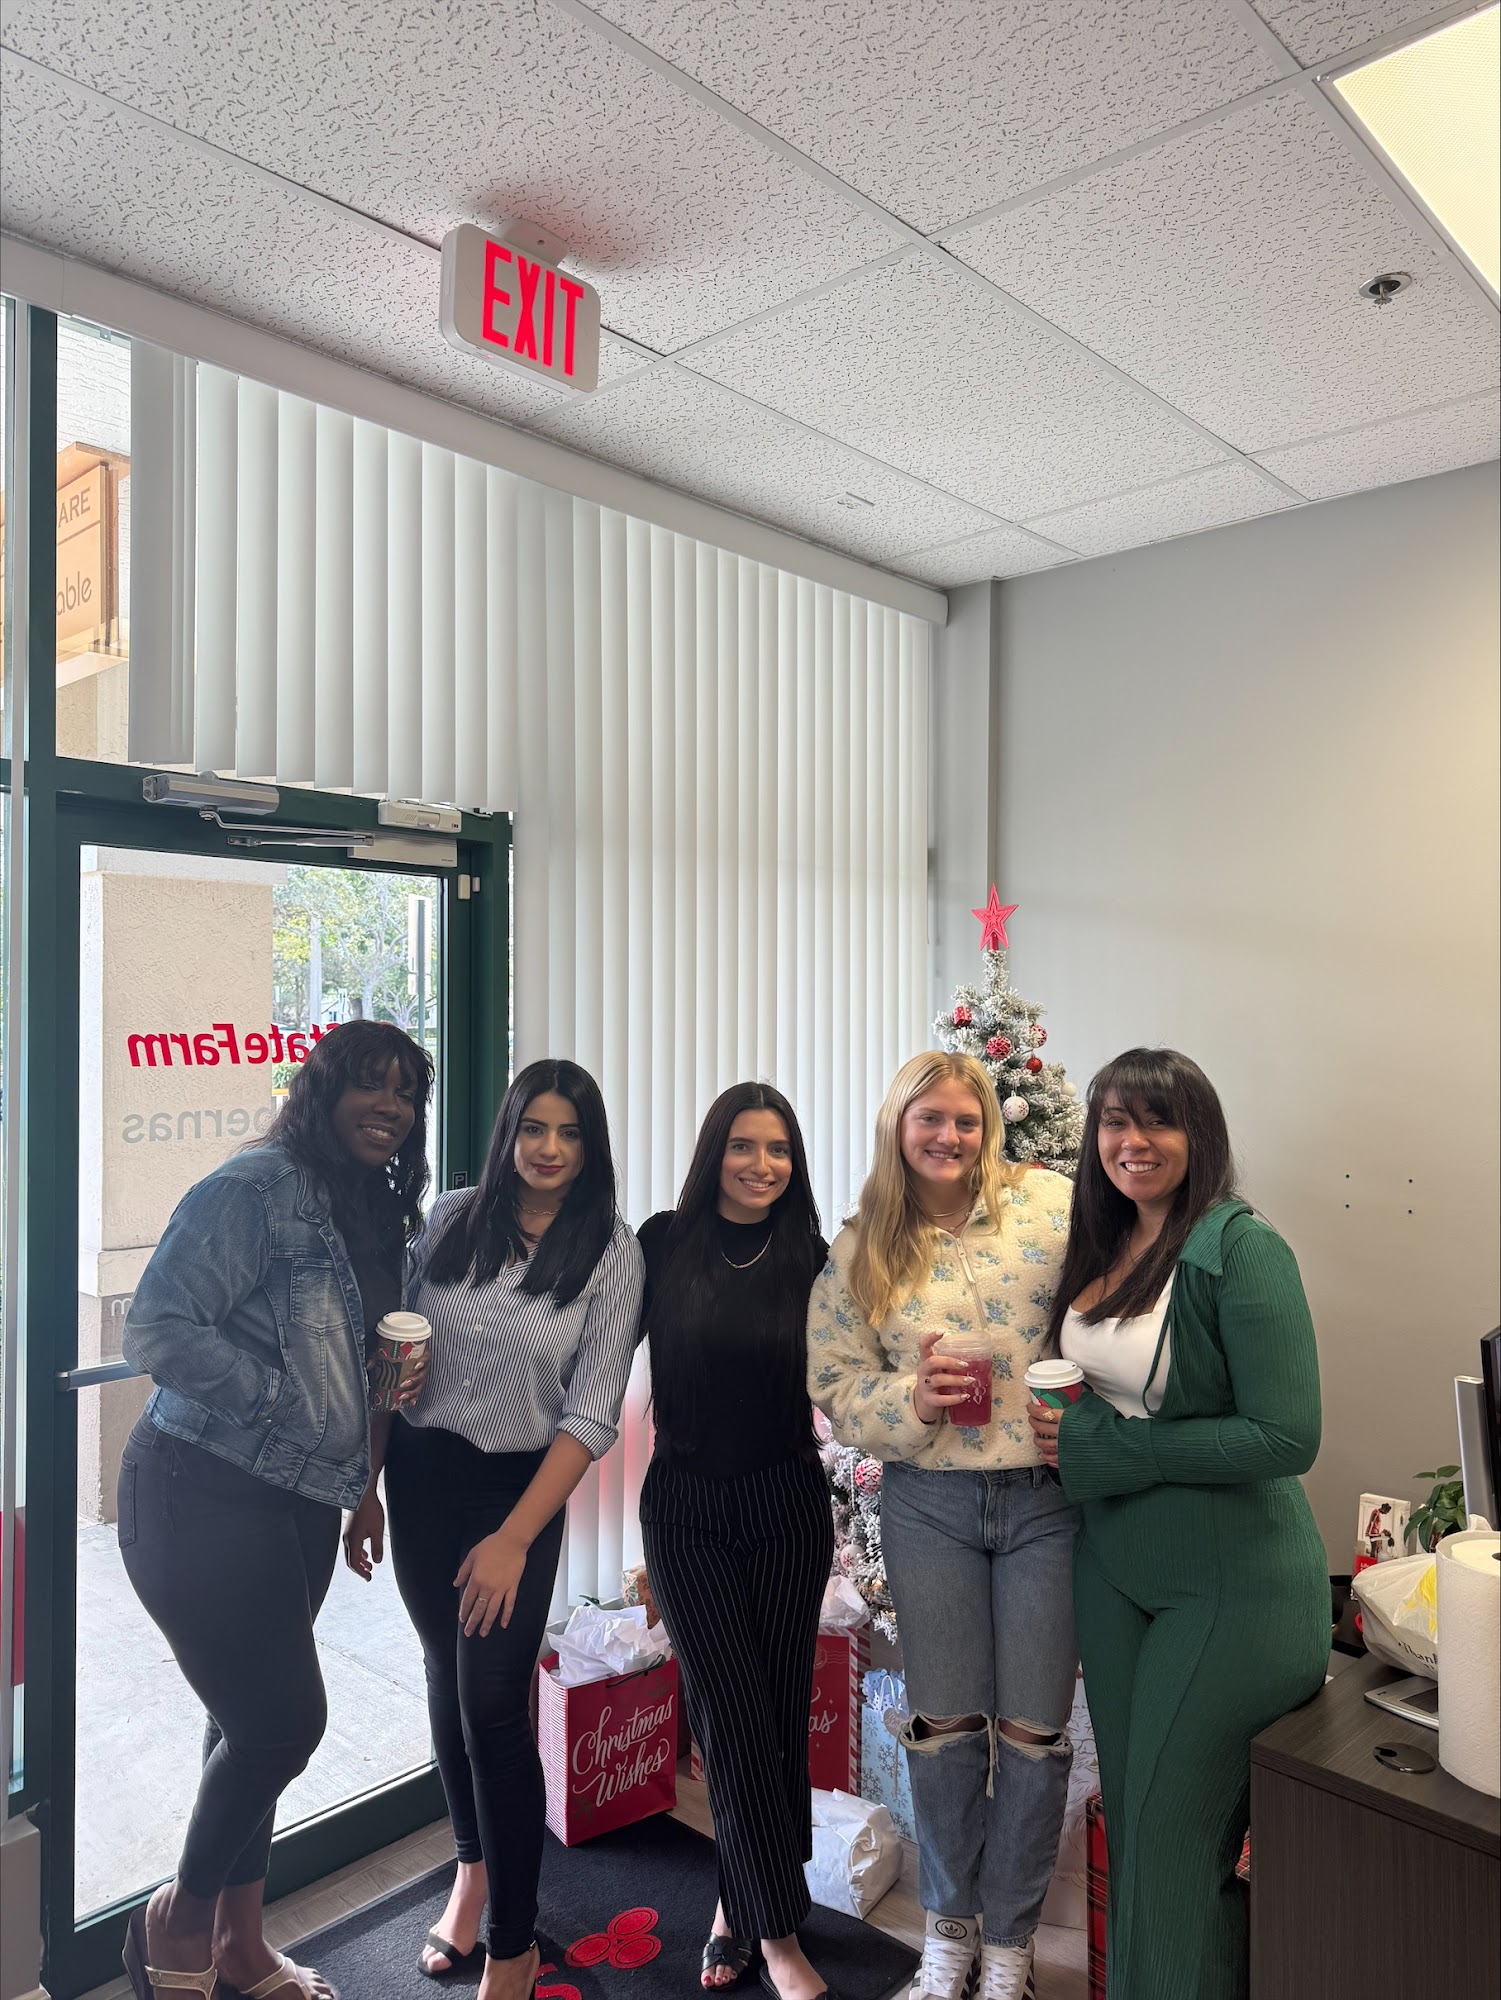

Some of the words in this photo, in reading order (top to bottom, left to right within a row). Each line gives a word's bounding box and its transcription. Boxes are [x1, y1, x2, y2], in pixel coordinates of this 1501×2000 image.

[482, 239, 585, 378] EXIT
[572, 1694, 674, 1775] Christmas
[572, 1738, 670, 1807] Wishes
